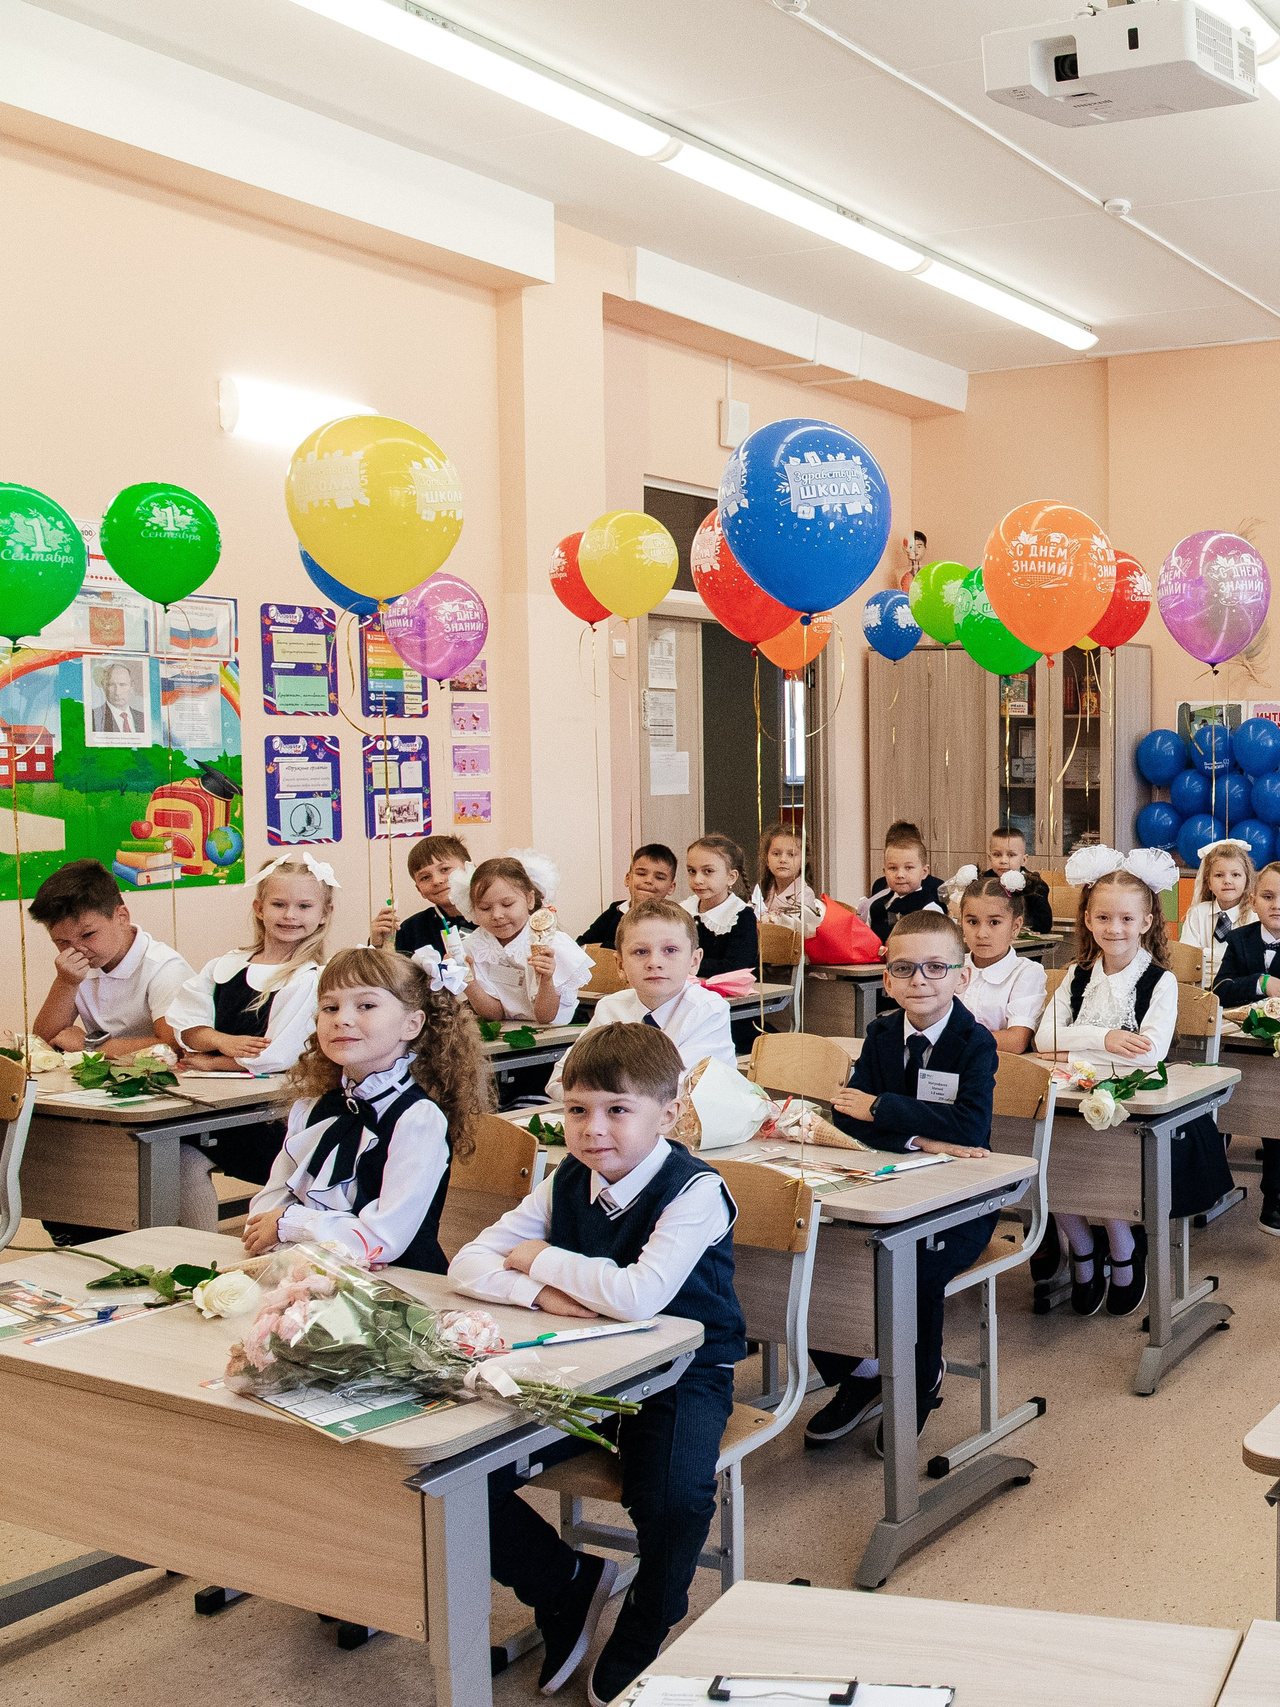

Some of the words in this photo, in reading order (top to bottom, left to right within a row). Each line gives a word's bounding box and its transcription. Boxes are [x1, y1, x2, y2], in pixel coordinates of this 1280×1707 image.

[799, 482, 861, 500] ШКОЛА
[161, 506, 180, 531] 1
[23, 517, 47, 552] 1
[140, 528, 201, 542] Сентября
[0, 548, 75, 568] Сентября
[1016, 543, 1024, 557] С
[1029, 542, 1069, 561] ДНЁМ
[1098, 548, 1105, 562] С
[1012, 559, 1074, 578] ЗНАНИЙ!
[1219, 569, 1228, 579] С
[1218, 580, 1264, 594] ЗНАНИЙ!
[444, 621, 485, 633] ЗНАНИЙ!
